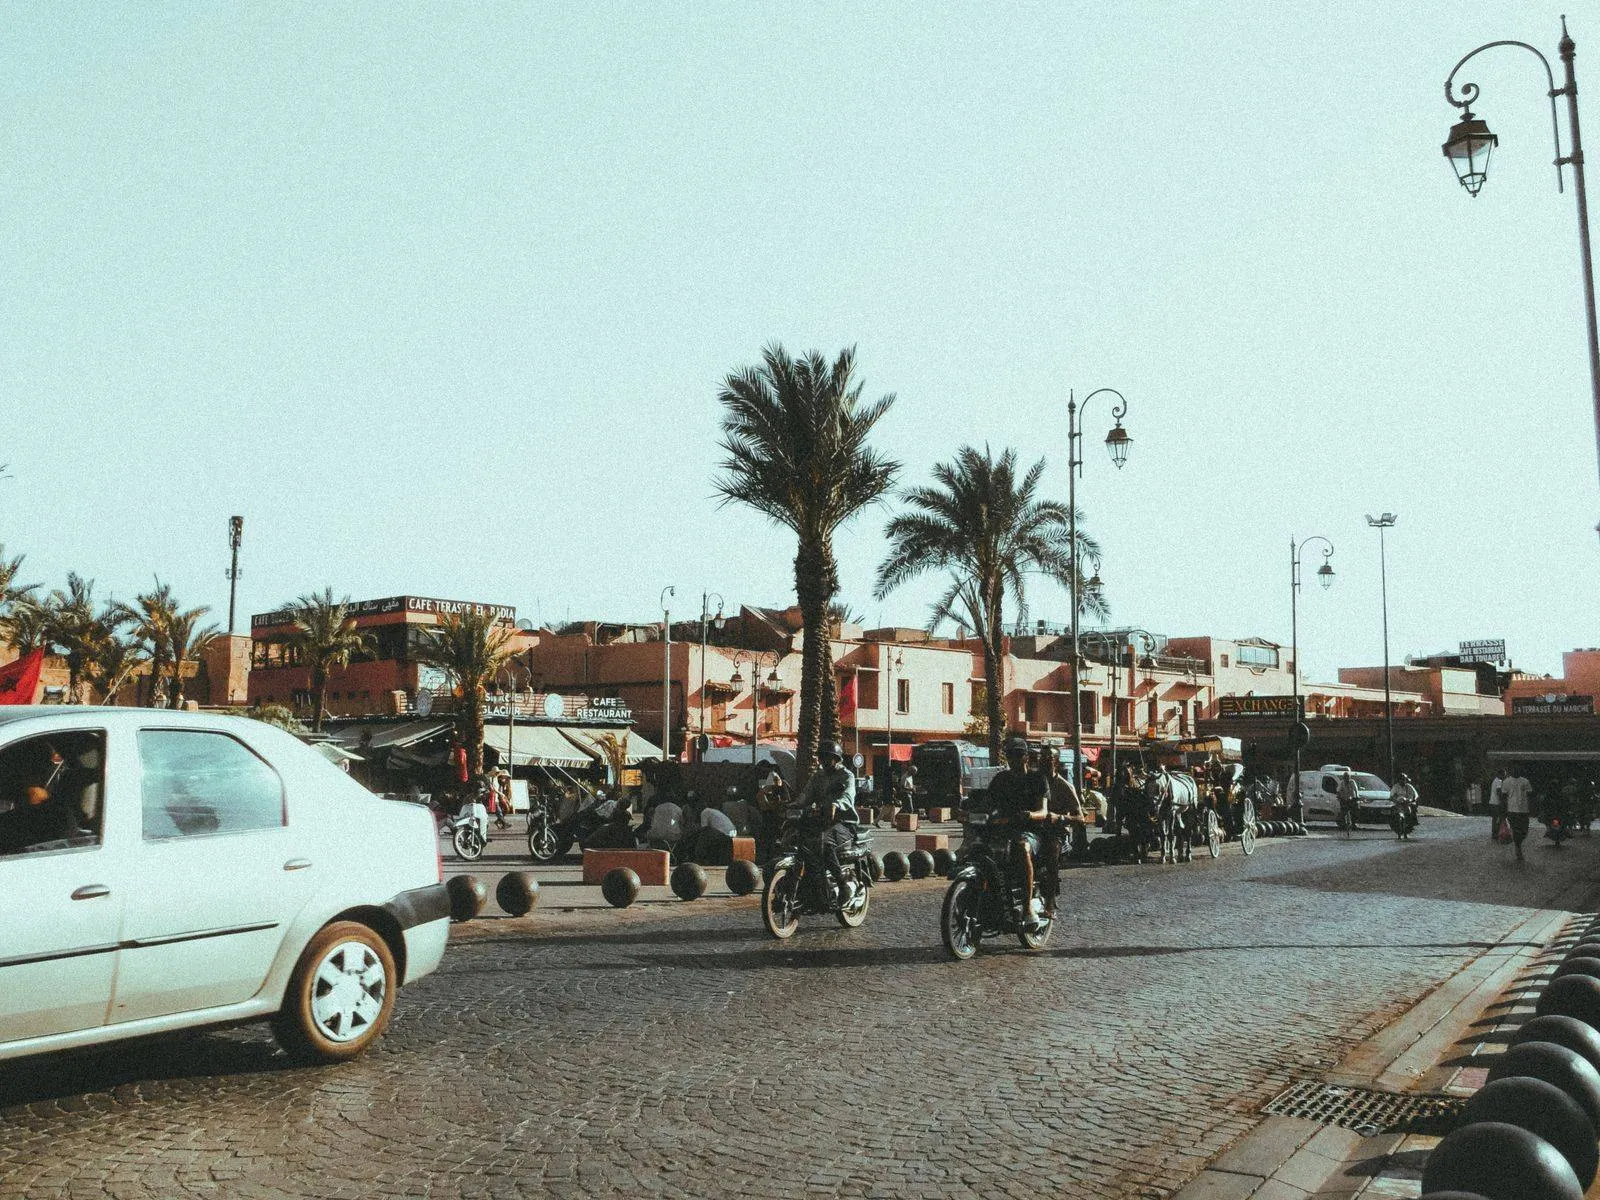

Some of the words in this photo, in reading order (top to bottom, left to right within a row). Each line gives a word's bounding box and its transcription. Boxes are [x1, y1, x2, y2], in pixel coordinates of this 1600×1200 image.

[409, 598, 432, 611] CAFE
[1460, 639, 1504, 648] TERRASSE
[593, 697, 617, 707] CAFE
[1223, 698, 1294, 712] EXCHANGE
[577, 708, 632, 718] RESTAURANT
